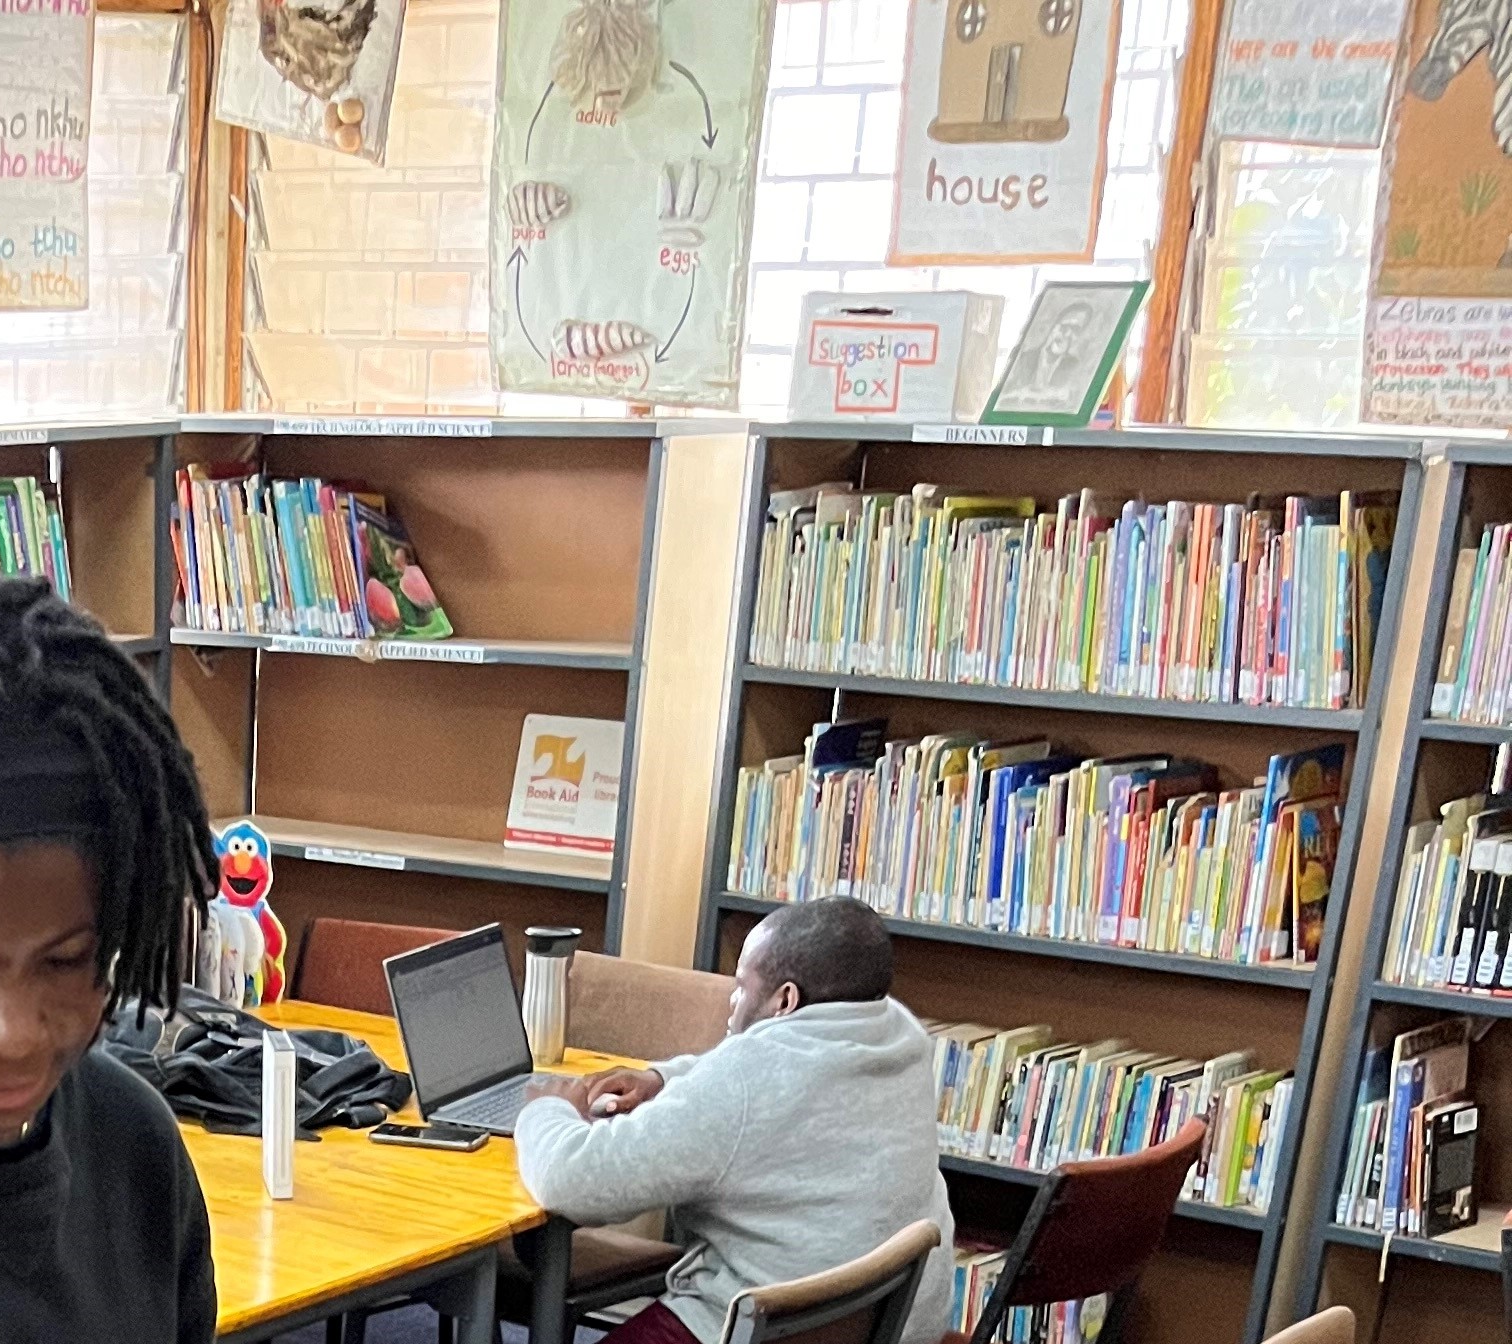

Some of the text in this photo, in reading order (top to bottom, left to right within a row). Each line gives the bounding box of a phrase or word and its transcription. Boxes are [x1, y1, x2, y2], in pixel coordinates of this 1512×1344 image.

[36, 97, 84, 142] nkhu
[926, 158, 1049, 210] house
[512, 225, 547, 251] pupa
[660, 246, 701, 275] eggs
[819, 336, 920, 367] Suggestion
[840, 370, 888, 399] box
[945, 427, 1025, 444] BEGINNERS
